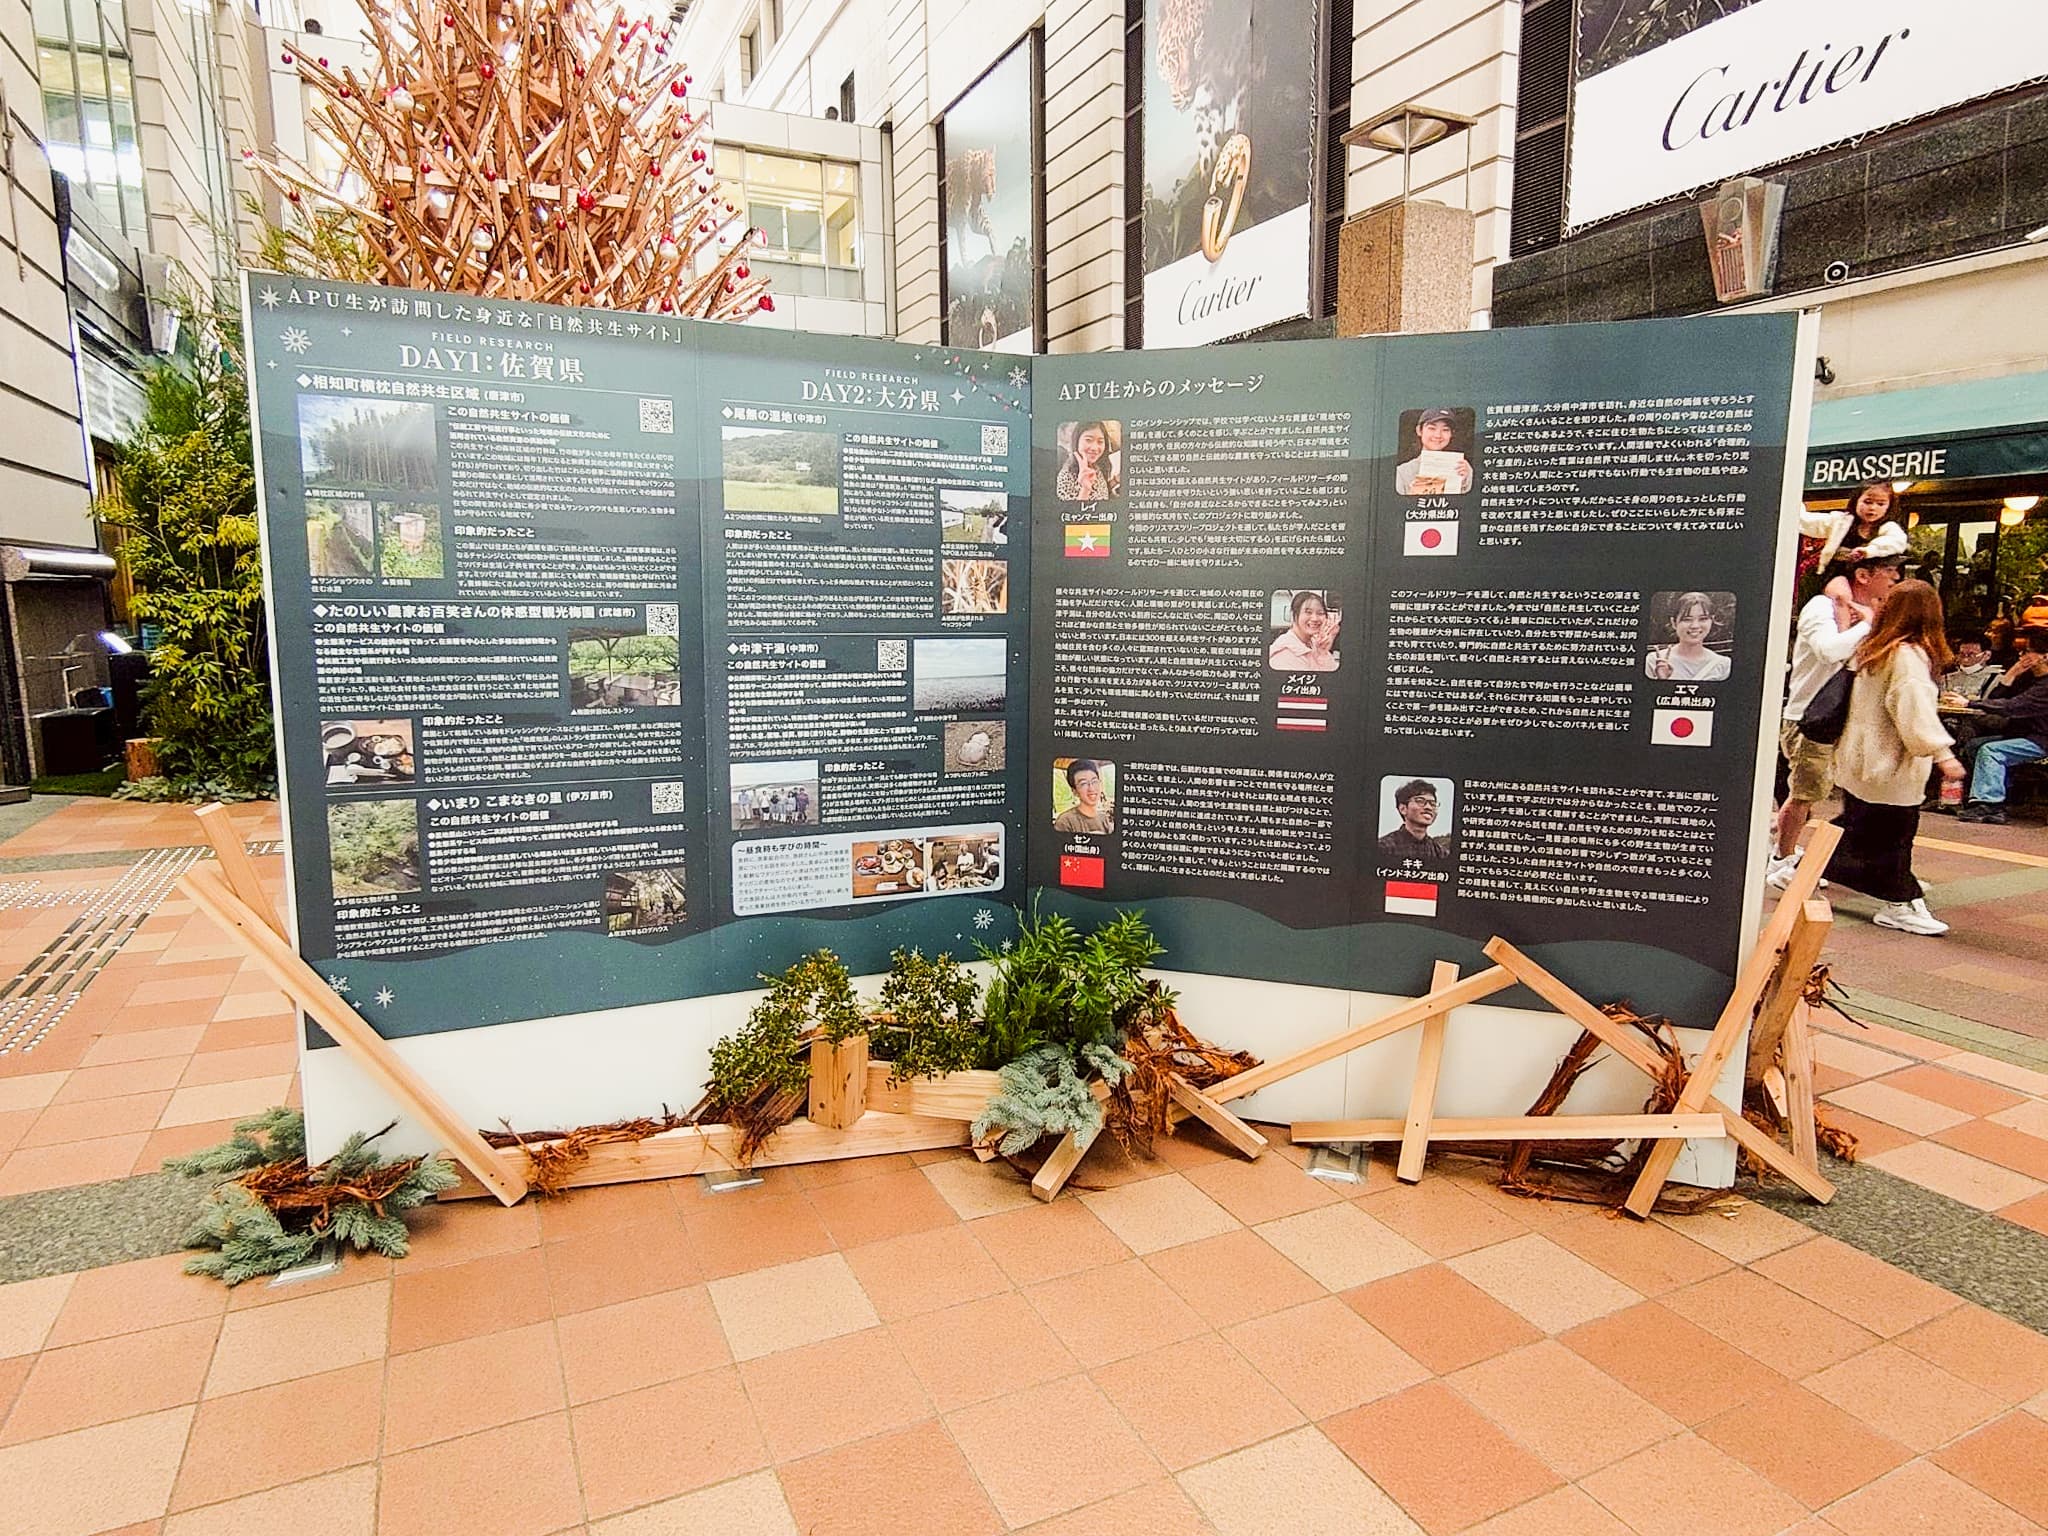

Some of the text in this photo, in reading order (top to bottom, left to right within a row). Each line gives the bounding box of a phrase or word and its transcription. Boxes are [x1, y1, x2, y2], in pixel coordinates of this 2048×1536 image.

[1662, 28, 1911, 152] Cartier
[1177, 272, 1264, 325] Cartier
[286, 288, 684, 342] APU生が訪問した身近な「自然共生サイト」
[431, 332, 554, 353] FIELD RESEARCH
[399, 343, 585, 383] DAY1:佐賀県
[825, 369, 919, 385] FIELD RESEARCH
[1058, 374, 1265, 401] APU生からのメッセージ
[802, 381, 941, 412] DAY2:大分県
[447, 406, 570, 424] この自然共生サイトの価値
[844, 433, 938, 448] この自然共生サイトの価値
[1812, 449, 1947, 484] BRASSERIE
[1080, 503, 1098, 512] レイ
[1416, 498, 1449, 507] ミハル
[1404, 509, 1460, 519] (大分県出身)
[454, 525, 535, 539] 印象的だったこと
[725, 530, 792, 541] 印象的だったこと
[1478, 536, 1522, 546] と思います。
[313, 622, 445, 634] この自然共生サイトの価値
[727, 660, 826, 669] この自然共生サイトの価値
[1287, 674, 1317, 684] メイジ
[1281, 685, 1321, 696] (タイ出身)
[1674, 685, 1698, 695] エマ
[1655, 696, 1716, 707] (広島県出身)
[422, 714, 504, 725] 印象的だったこと
[824, 762, 885, 772] 印象的だったこと
[441, 797, 480, 809] いまり
[486, 792, 562, 808] こまなきの里
[429, 811, 550, 826] この自然共生サイトの価値
[1074, 835, 1090, 844] セン
[1402, 858, 1423, 868] キキ
[1376, 867, 1449, 882] (インドネシア出身)
[336, 903, 421, 919] 印象的だったこと
